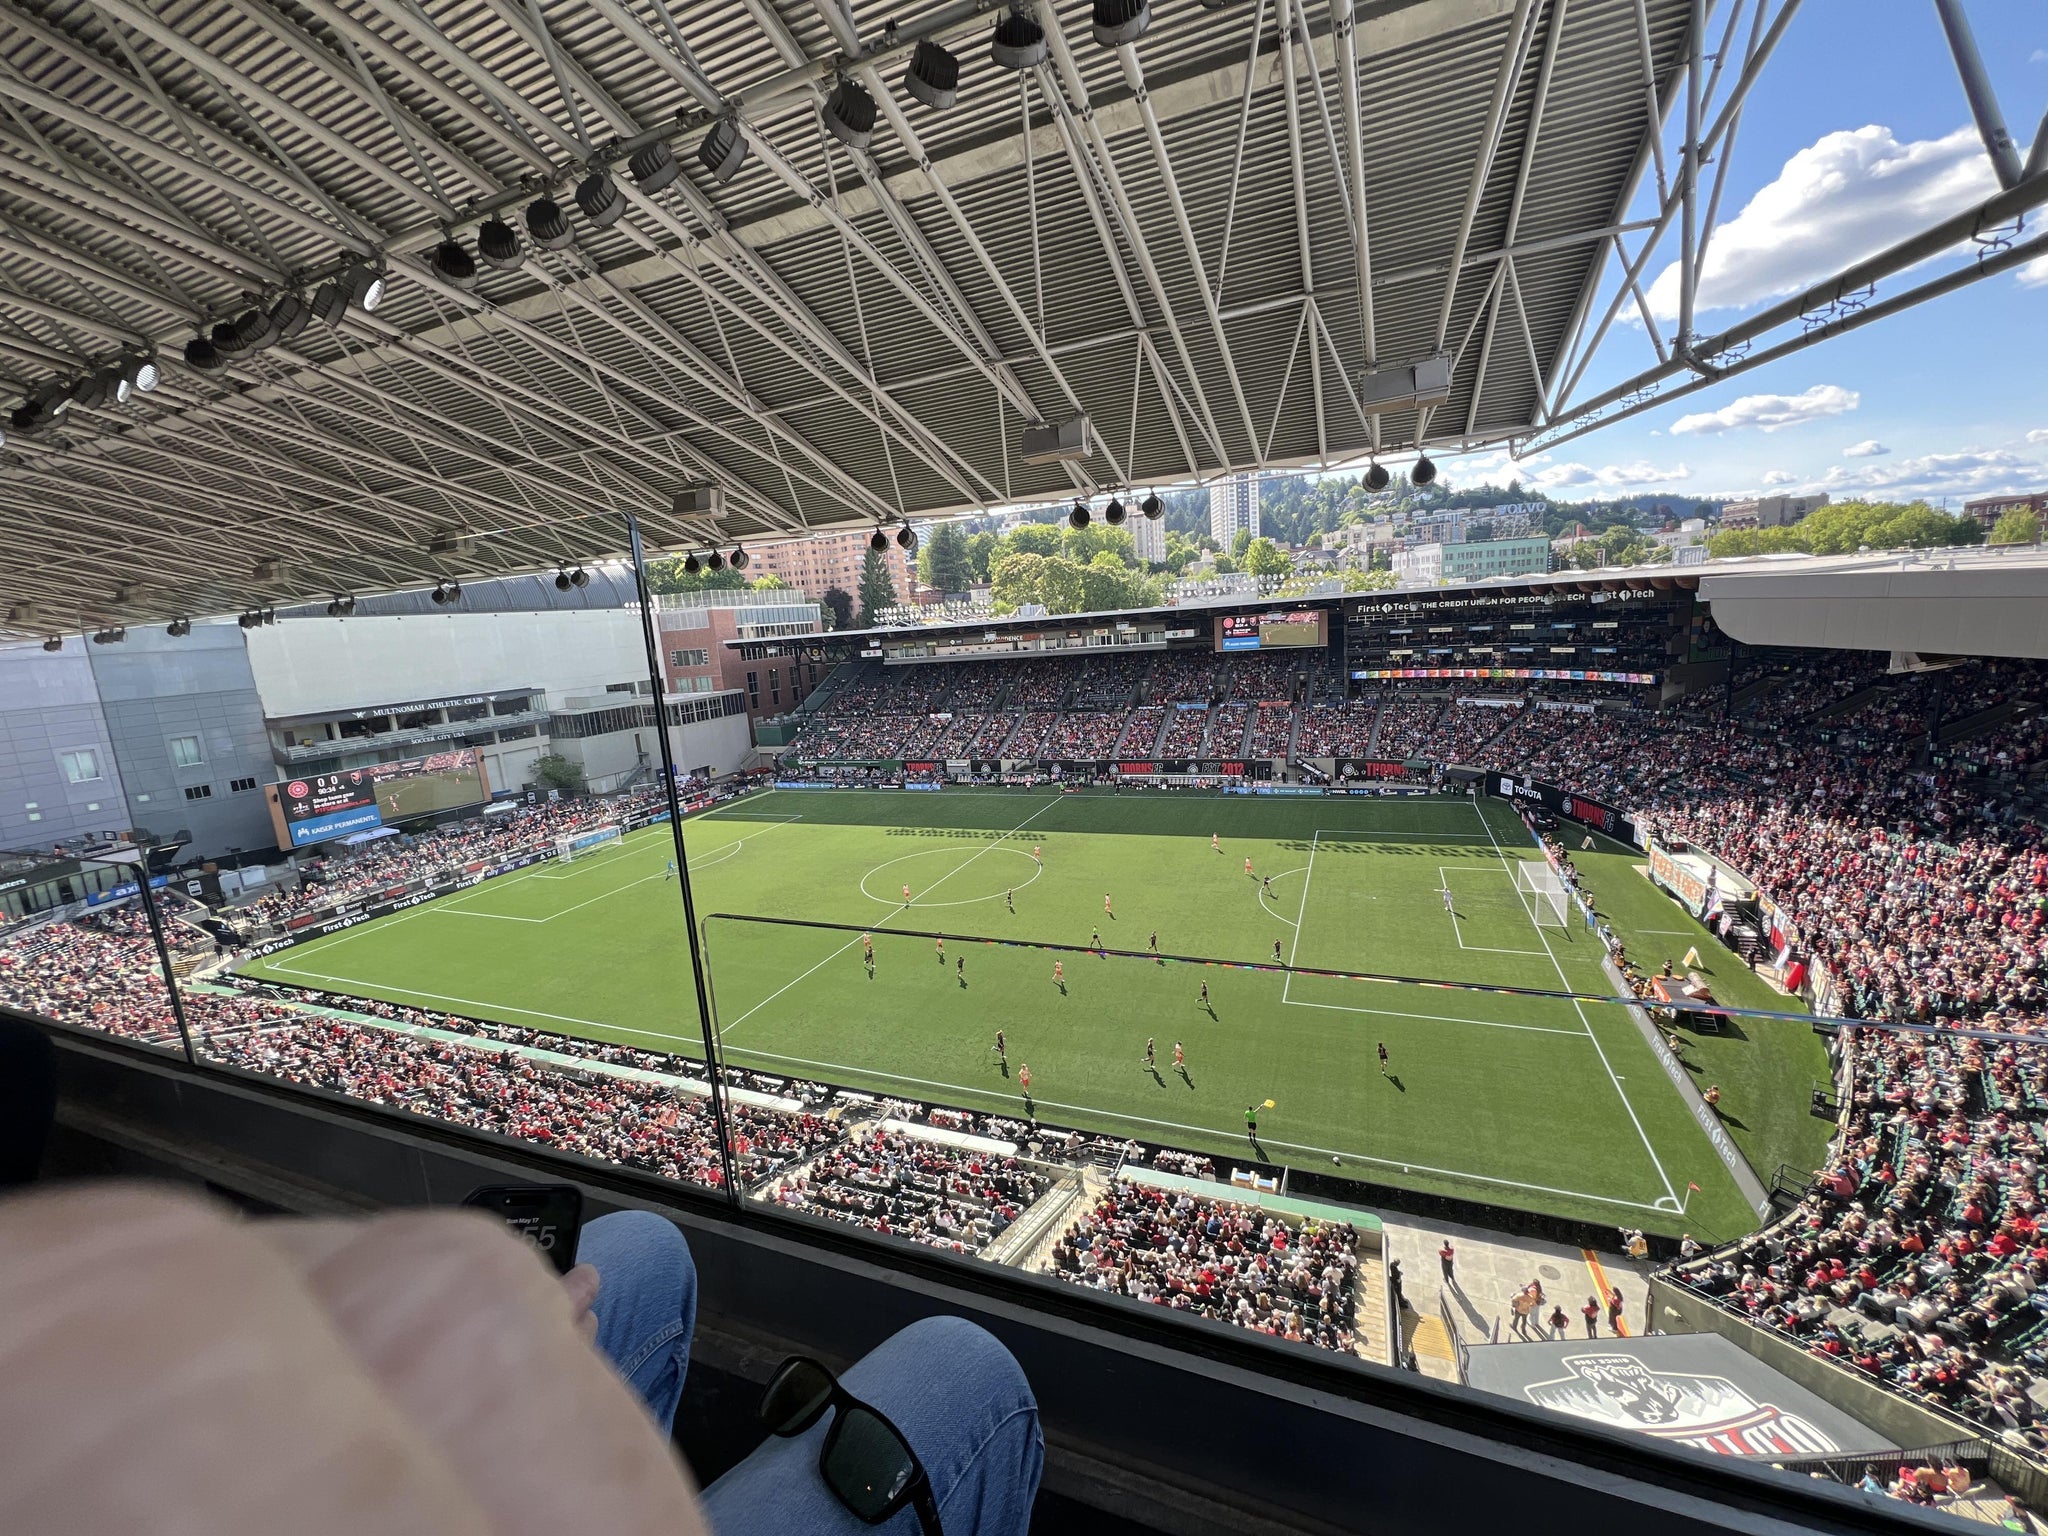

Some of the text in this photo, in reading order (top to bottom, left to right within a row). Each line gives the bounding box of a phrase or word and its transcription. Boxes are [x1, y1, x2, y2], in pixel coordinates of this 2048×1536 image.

[1496, 502, 1546, 516] VOLVO
[1631, 589, 1655, 598] Tech
[1357, 602, 1410, 613] First Tec
[1421, 601, 1437, 609] THE
[1439, 599, 1469, 608] CREDIT
[1471, 598, 1498, 606] UNN
[1518, 595, 1546, 604] PEOPL
[372, 696, 484, 717] MULTNOMAH ATHLETIC CLUB
[411, 736, 435, 745] SOCCER
[437, 733, 451, 741] CITY
[1118, 762, 1153, 774] THORNS
[1221, 762, 1244, 775] 2012
[317, 775, 338, 787] 0 0
[1514, 784, 1542, 801] TOYOTA
[1571, 798, 1605, 829] THORNS
[311, 825, 334, 834] KAISER
[456, 880, 472, 889] First
[393, 891, 436, 910] First Tech
[322, 919, 343, 933] First
[352, 913, 370, 924] Tech
[272, 938, 295, 949] Tech
[1651, 1035, 1682, 1084] First Tech
[1696, 1104, 1737, 1168] First Tech
